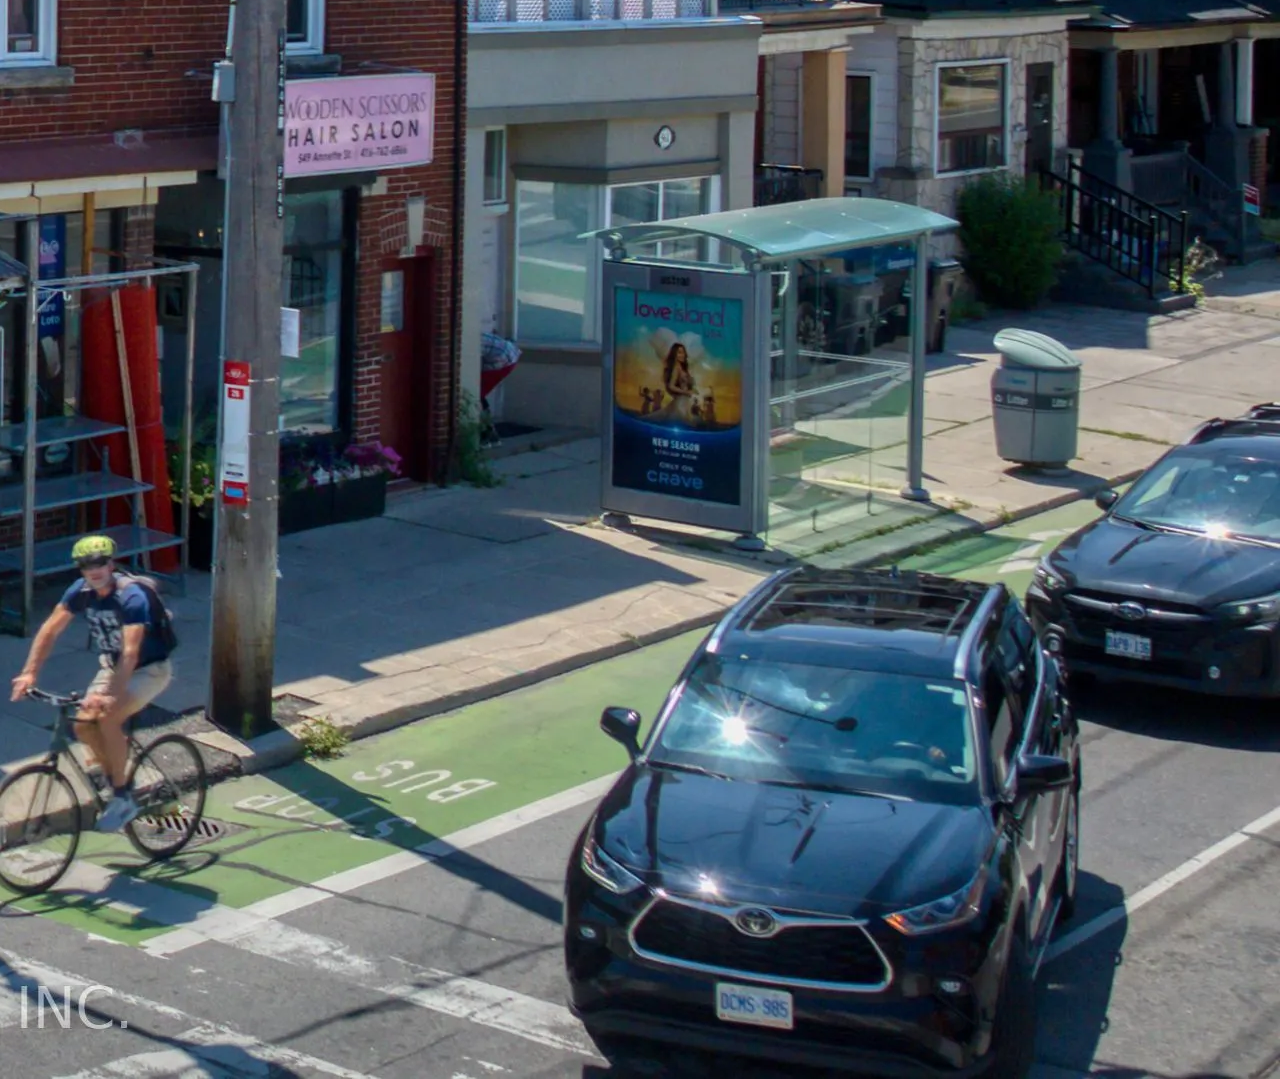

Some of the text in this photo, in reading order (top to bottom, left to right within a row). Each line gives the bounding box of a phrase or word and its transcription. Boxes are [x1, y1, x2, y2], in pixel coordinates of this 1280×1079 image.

[358, 92, 427, 119] SCISSORS
[288, 119, 419, 147] HAIR SALON
[634, 290, 726, 328] love island
[670, 440, 700, 452] SEASON
[351, 759, 497, 803] BUS
